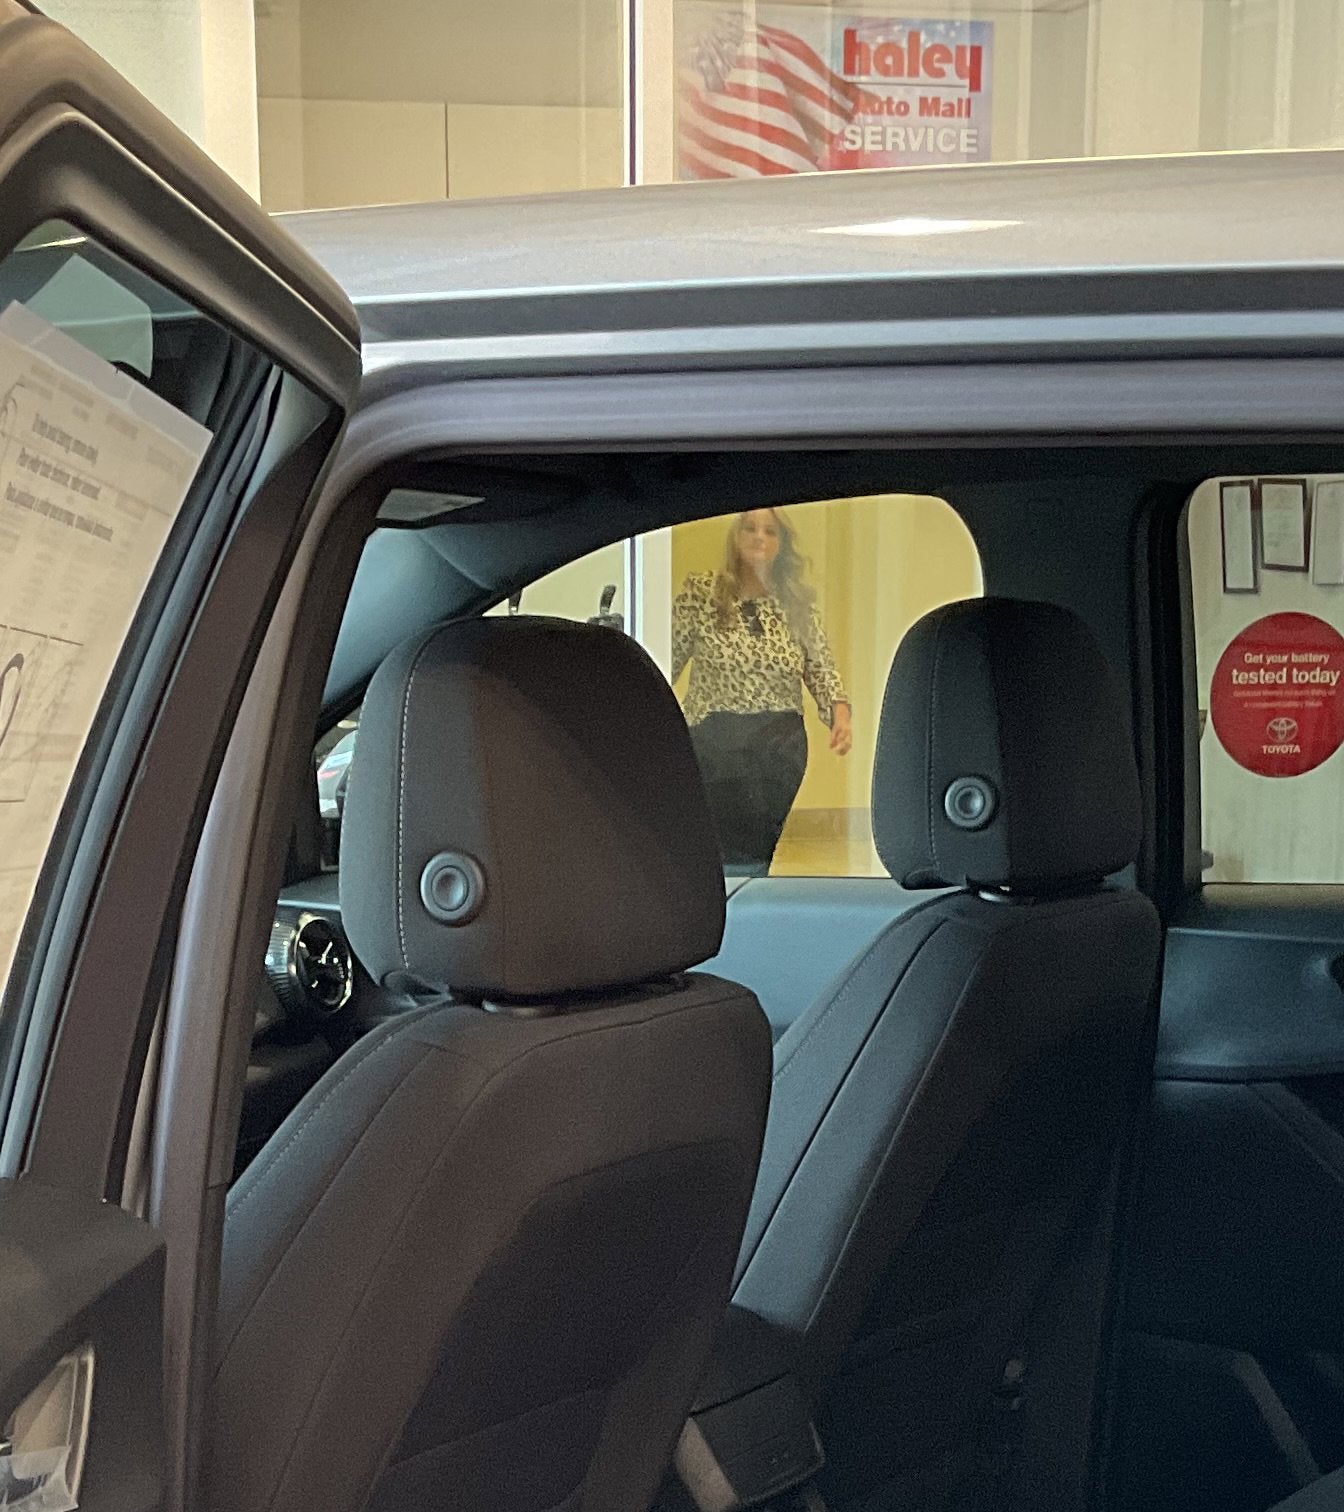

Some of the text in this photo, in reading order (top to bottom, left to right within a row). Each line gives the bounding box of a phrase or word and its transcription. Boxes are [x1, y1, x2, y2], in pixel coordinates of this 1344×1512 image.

[843, 28, 983, 93] haley
[852, 95, 971, 119] Auto Mall
[844, 125, 978, 153] SERVICE
[1244, 652, 1330, 665] Get your battery
[1231, 667, 1341, 687] tested today
[1262, 745, 1301, 754] TOYOTA
